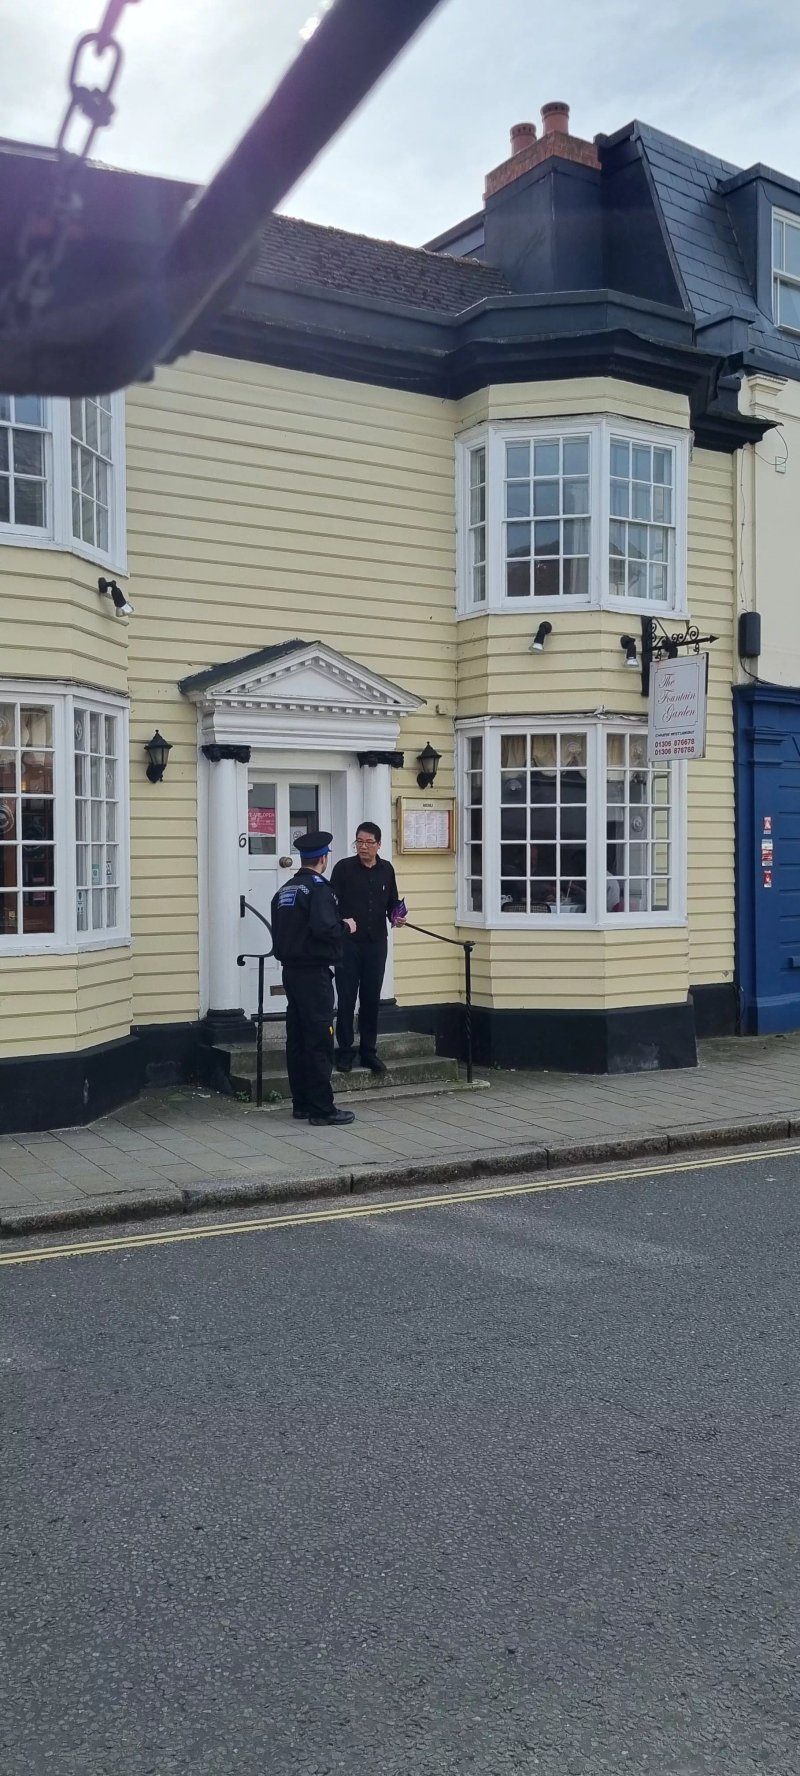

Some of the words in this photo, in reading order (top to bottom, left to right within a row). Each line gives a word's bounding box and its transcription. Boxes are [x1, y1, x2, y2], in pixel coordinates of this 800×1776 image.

[659, 673, 675, 688] The
[658, 690, 696, 704] Fountain
[662, 703, 695, 722] Garden
[238, 833, 247, 848] 6
